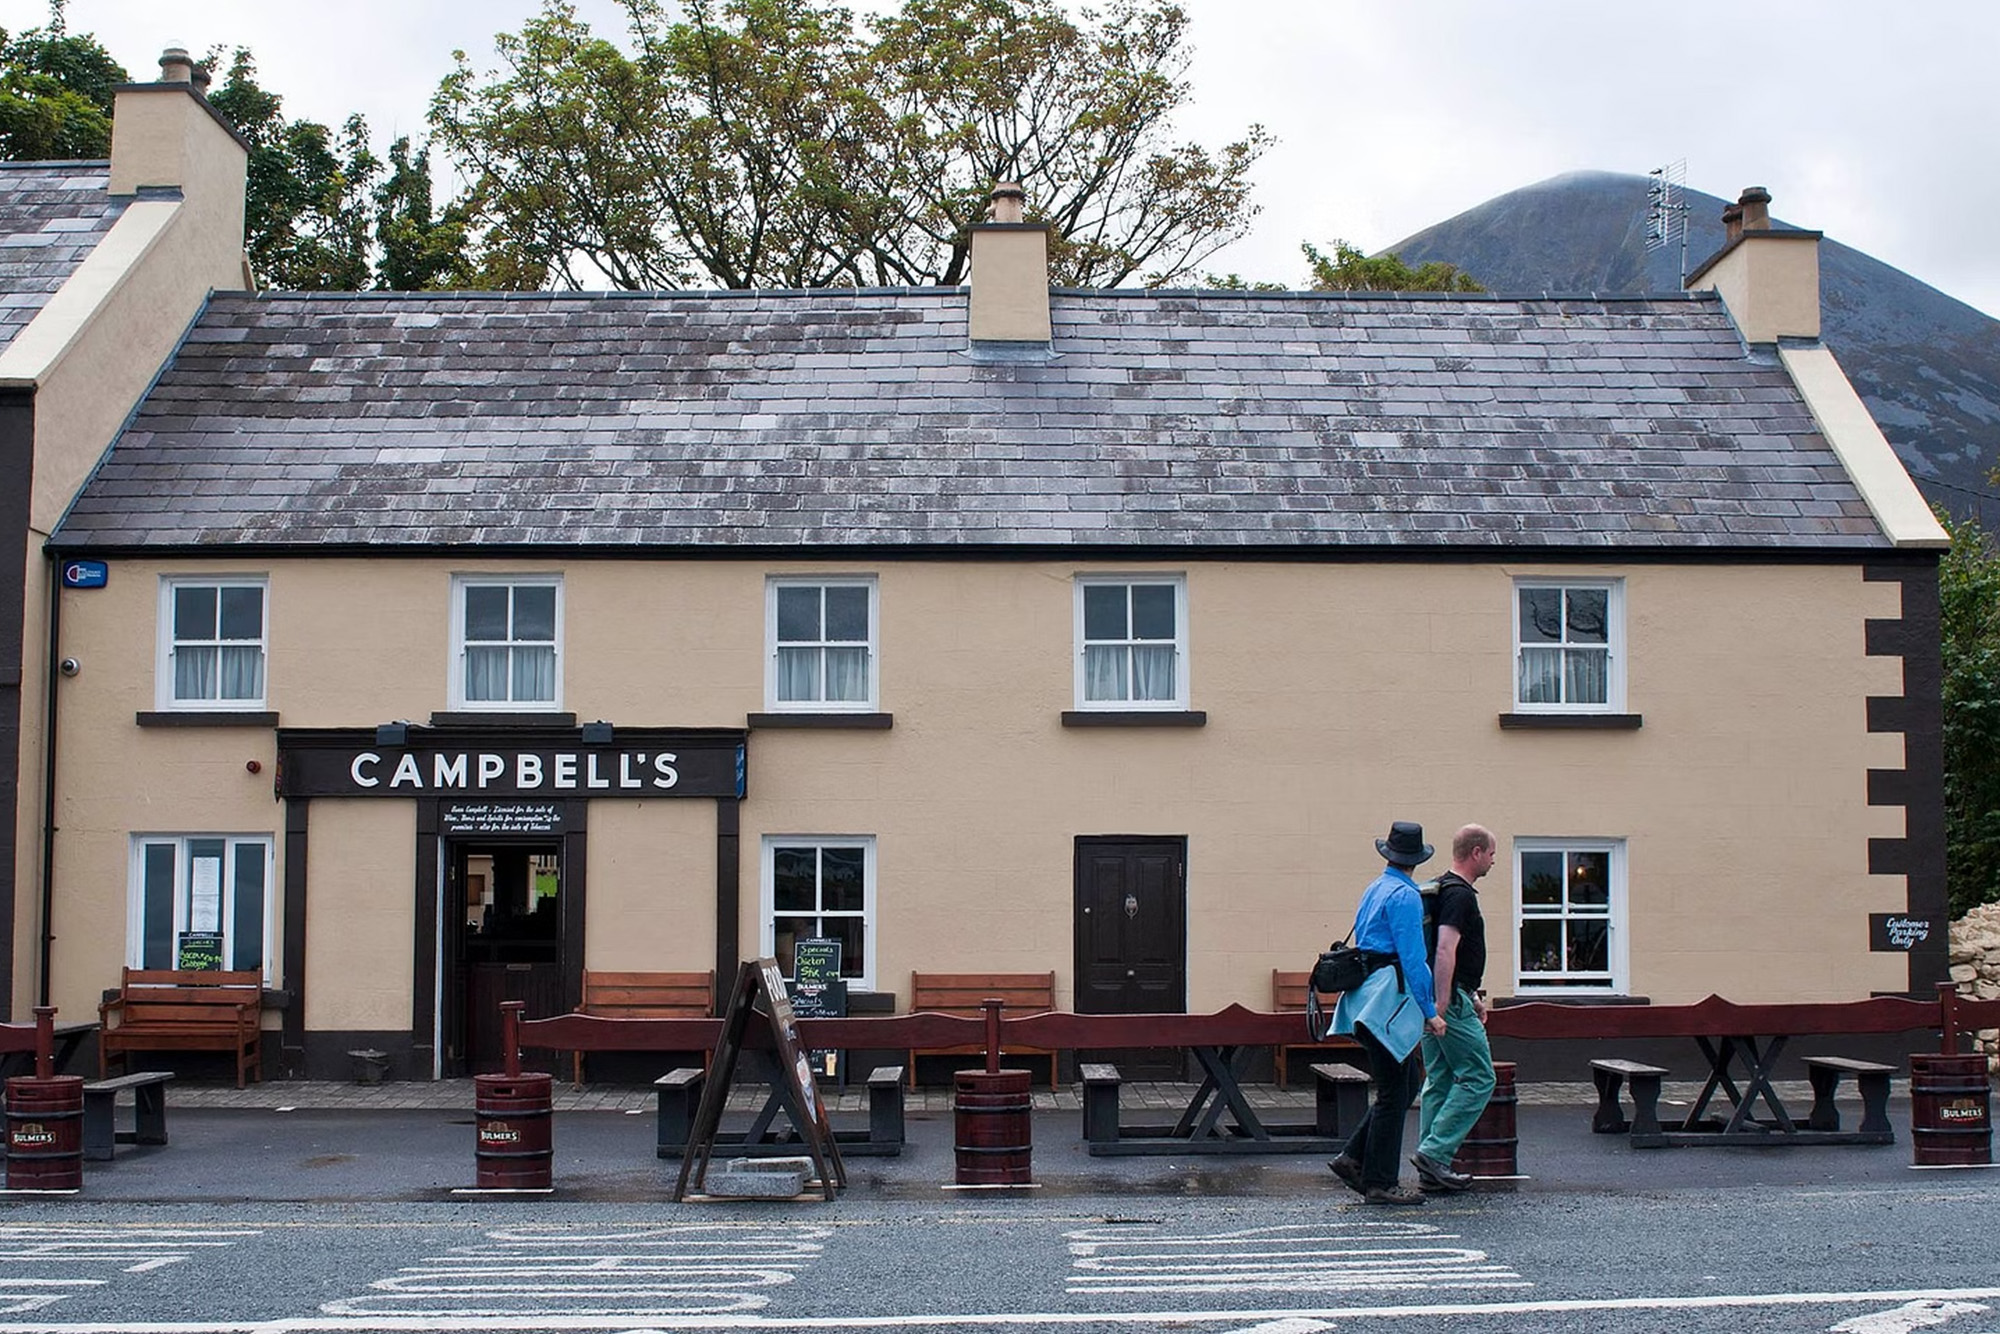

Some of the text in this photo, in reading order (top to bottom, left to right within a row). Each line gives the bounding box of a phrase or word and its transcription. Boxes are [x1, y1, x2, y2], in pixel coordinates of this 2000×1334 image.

[350, 752, 678, 790] CAMPBELL'S
[515, 805, 525, 814] for
[526, 805, 535, 813] the
[546, 805, 554, 814] of
[501, 822, 510, 830] the
[522, 822, 530, 832] of
[1889, 927, 1929, 941] Parking
[1891, 936, 1915, 949] Only
[1942, 1108, 1983, 1118] BULMERS
[13, 1133, 53, 1143] BULMERS
[480, 1131, 518, 1140] BULMERS
